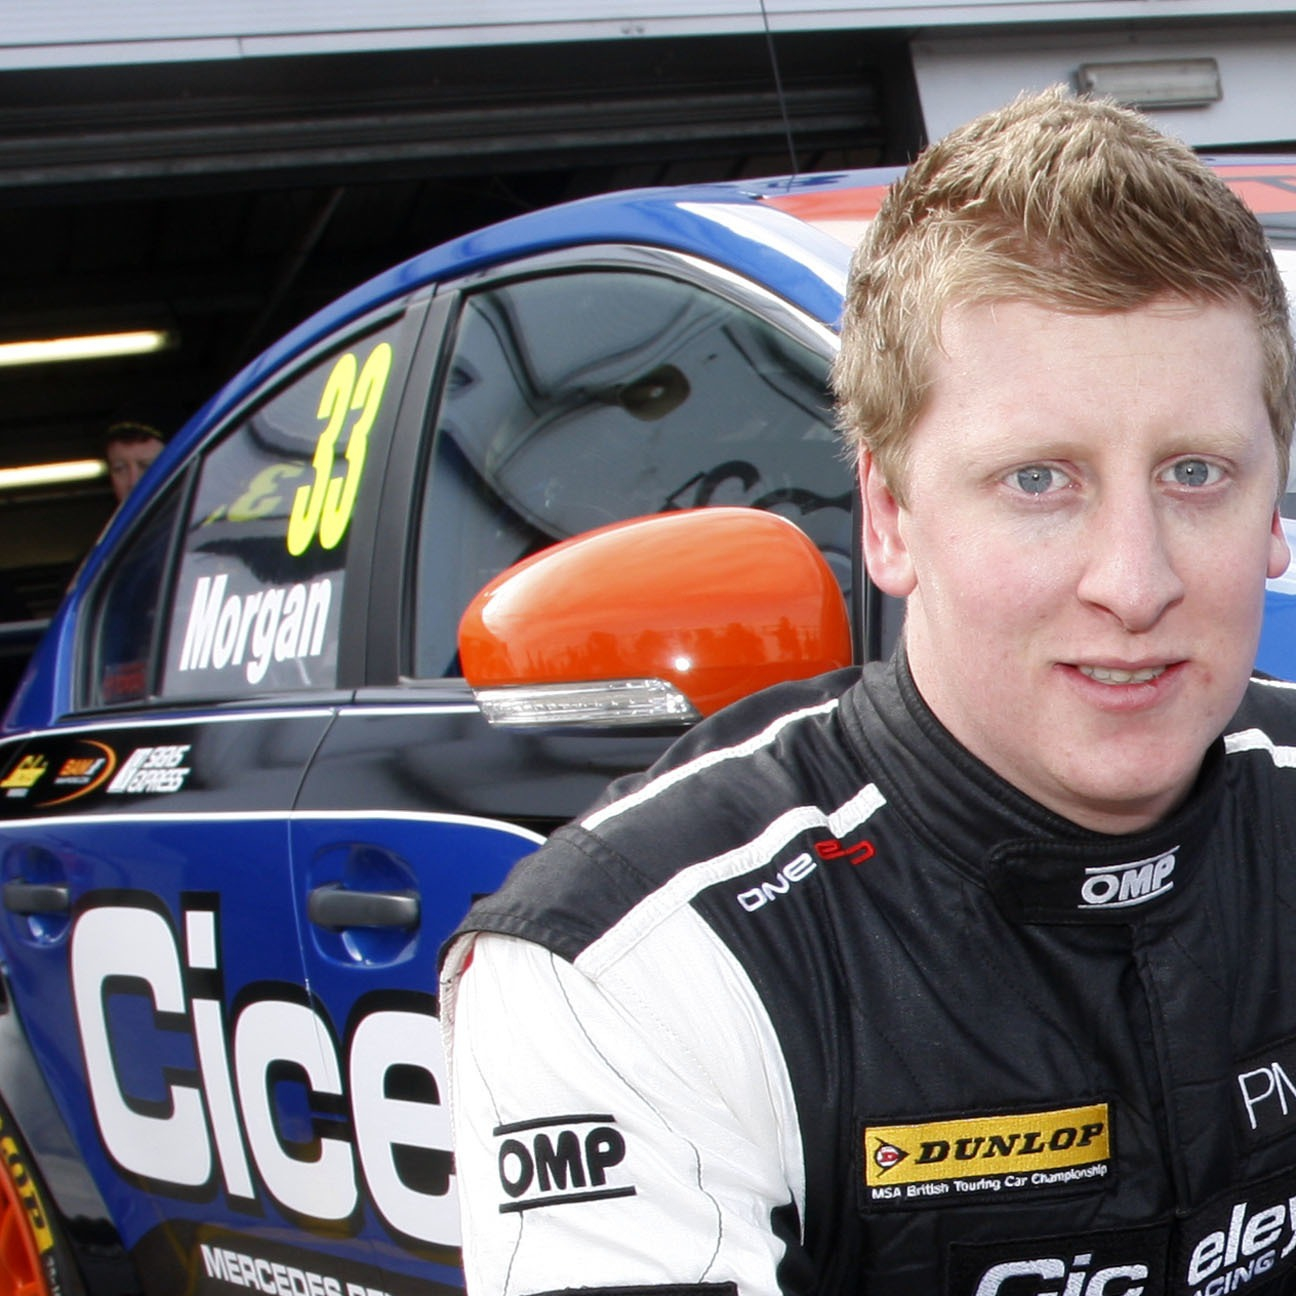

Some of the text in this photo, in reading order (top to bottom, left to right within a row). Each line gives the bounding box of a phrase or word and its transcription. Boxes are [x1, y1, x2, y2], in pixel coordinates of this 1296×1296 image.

[287, 342, 392, 557] 33
[179, 574, 332, 685] Morgan
[1081, 854, 1176, 904] OMP
[499, 1127, 626, 1198] OMP
[915, 1122, 1104, 1165] DUNLOP
[872, 1163, 1108, 1200] MSA British Touring Car Championship
